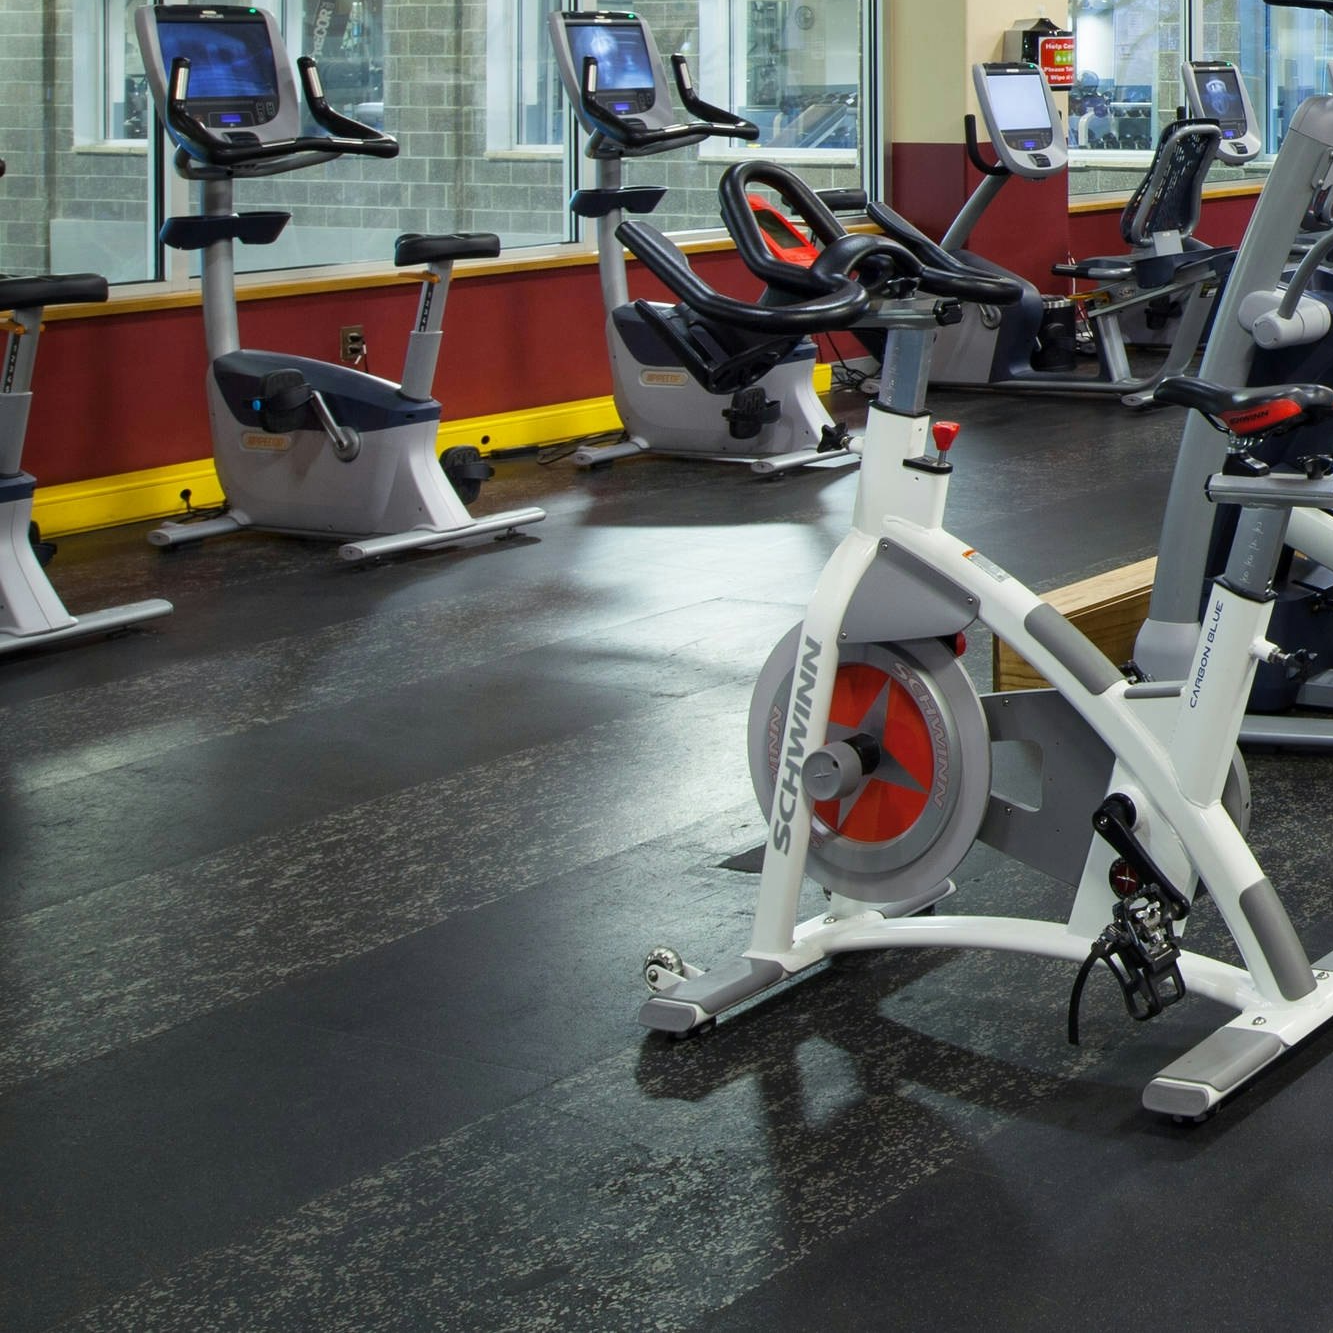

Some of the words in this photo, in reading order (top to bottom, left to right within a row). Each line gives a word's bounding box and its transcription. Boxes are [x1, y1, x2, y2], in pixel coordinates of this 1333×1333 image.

[1190, 646, 1211, 708] CARBON
[1207, 599, 1223, 643] BLUE
[773, 636, 823, 857] SCHWINN
[893, 662, 950, 810] SCHWINN
